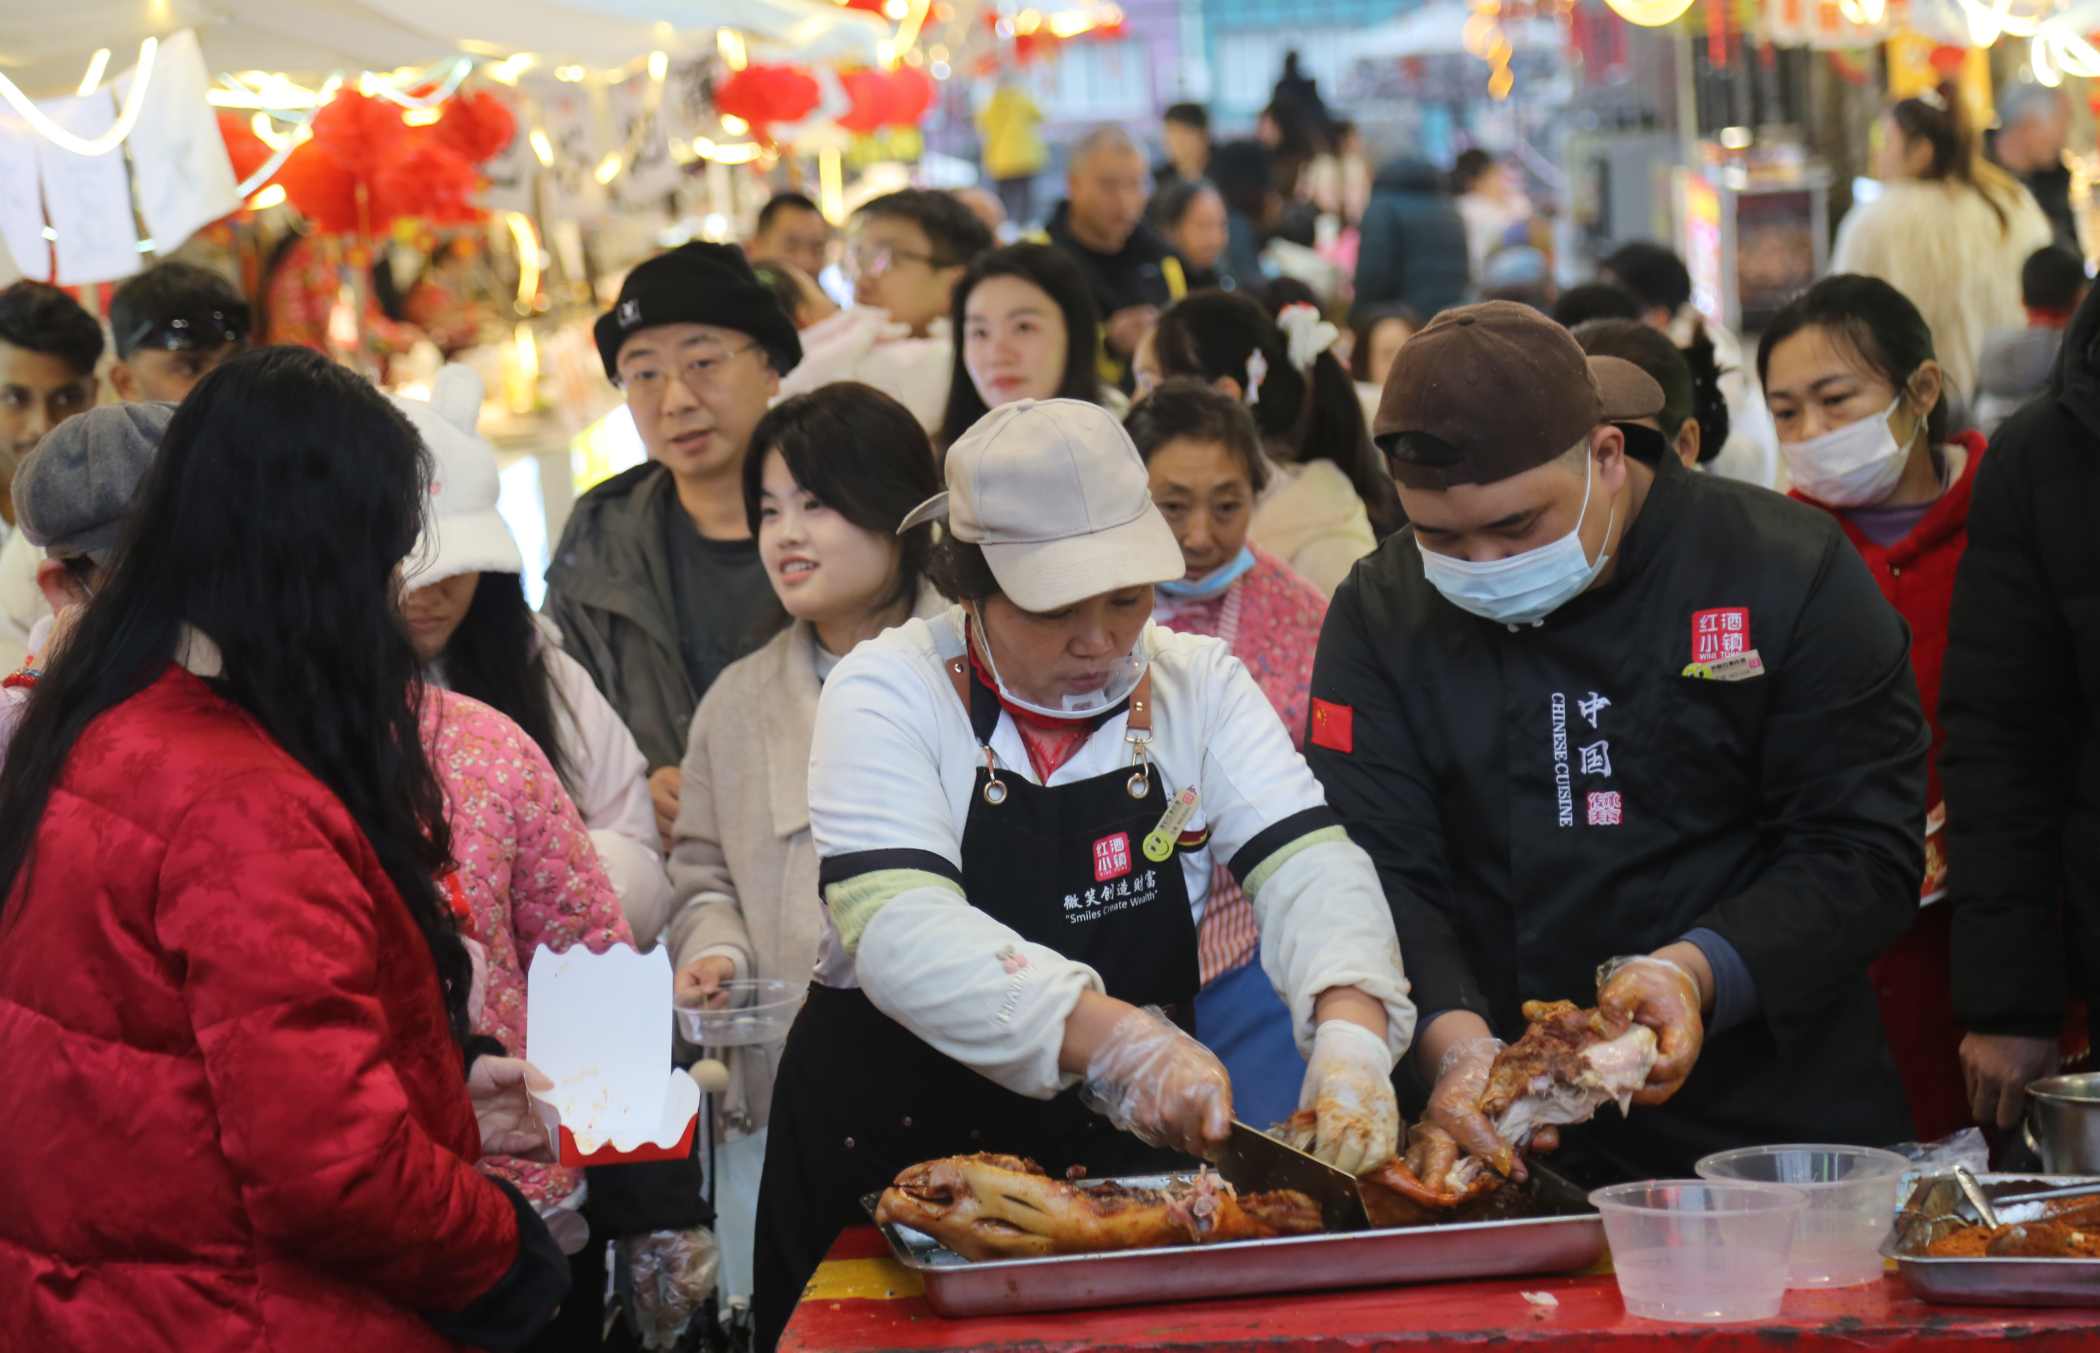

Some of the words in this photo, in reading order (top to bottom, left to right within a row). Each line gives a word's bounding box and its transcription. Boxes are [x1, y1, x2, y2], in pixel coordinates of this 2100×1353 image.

[1699, 612, 1743, 633] 红酒
[1699, 632, 1744, 653] 小镇
[1699, 651, 1718, 661] WINE
[1551, 692, 1568, 761] CHINESE
[1577, 691, 1612, 778] 中国
[1554, 762, 1573, 828] CUISINE
[1096, 837, 1125, 858] 红酒
[1098, 852, 1128, 872] 小镇
[1063, 869, 1157, 911] 微笑创造财富
[1065, 910, 1102, 925] "Smiles
[1102, 900, 1128, 915] Create
[1129, 889, 1159, 907] Wealth"
